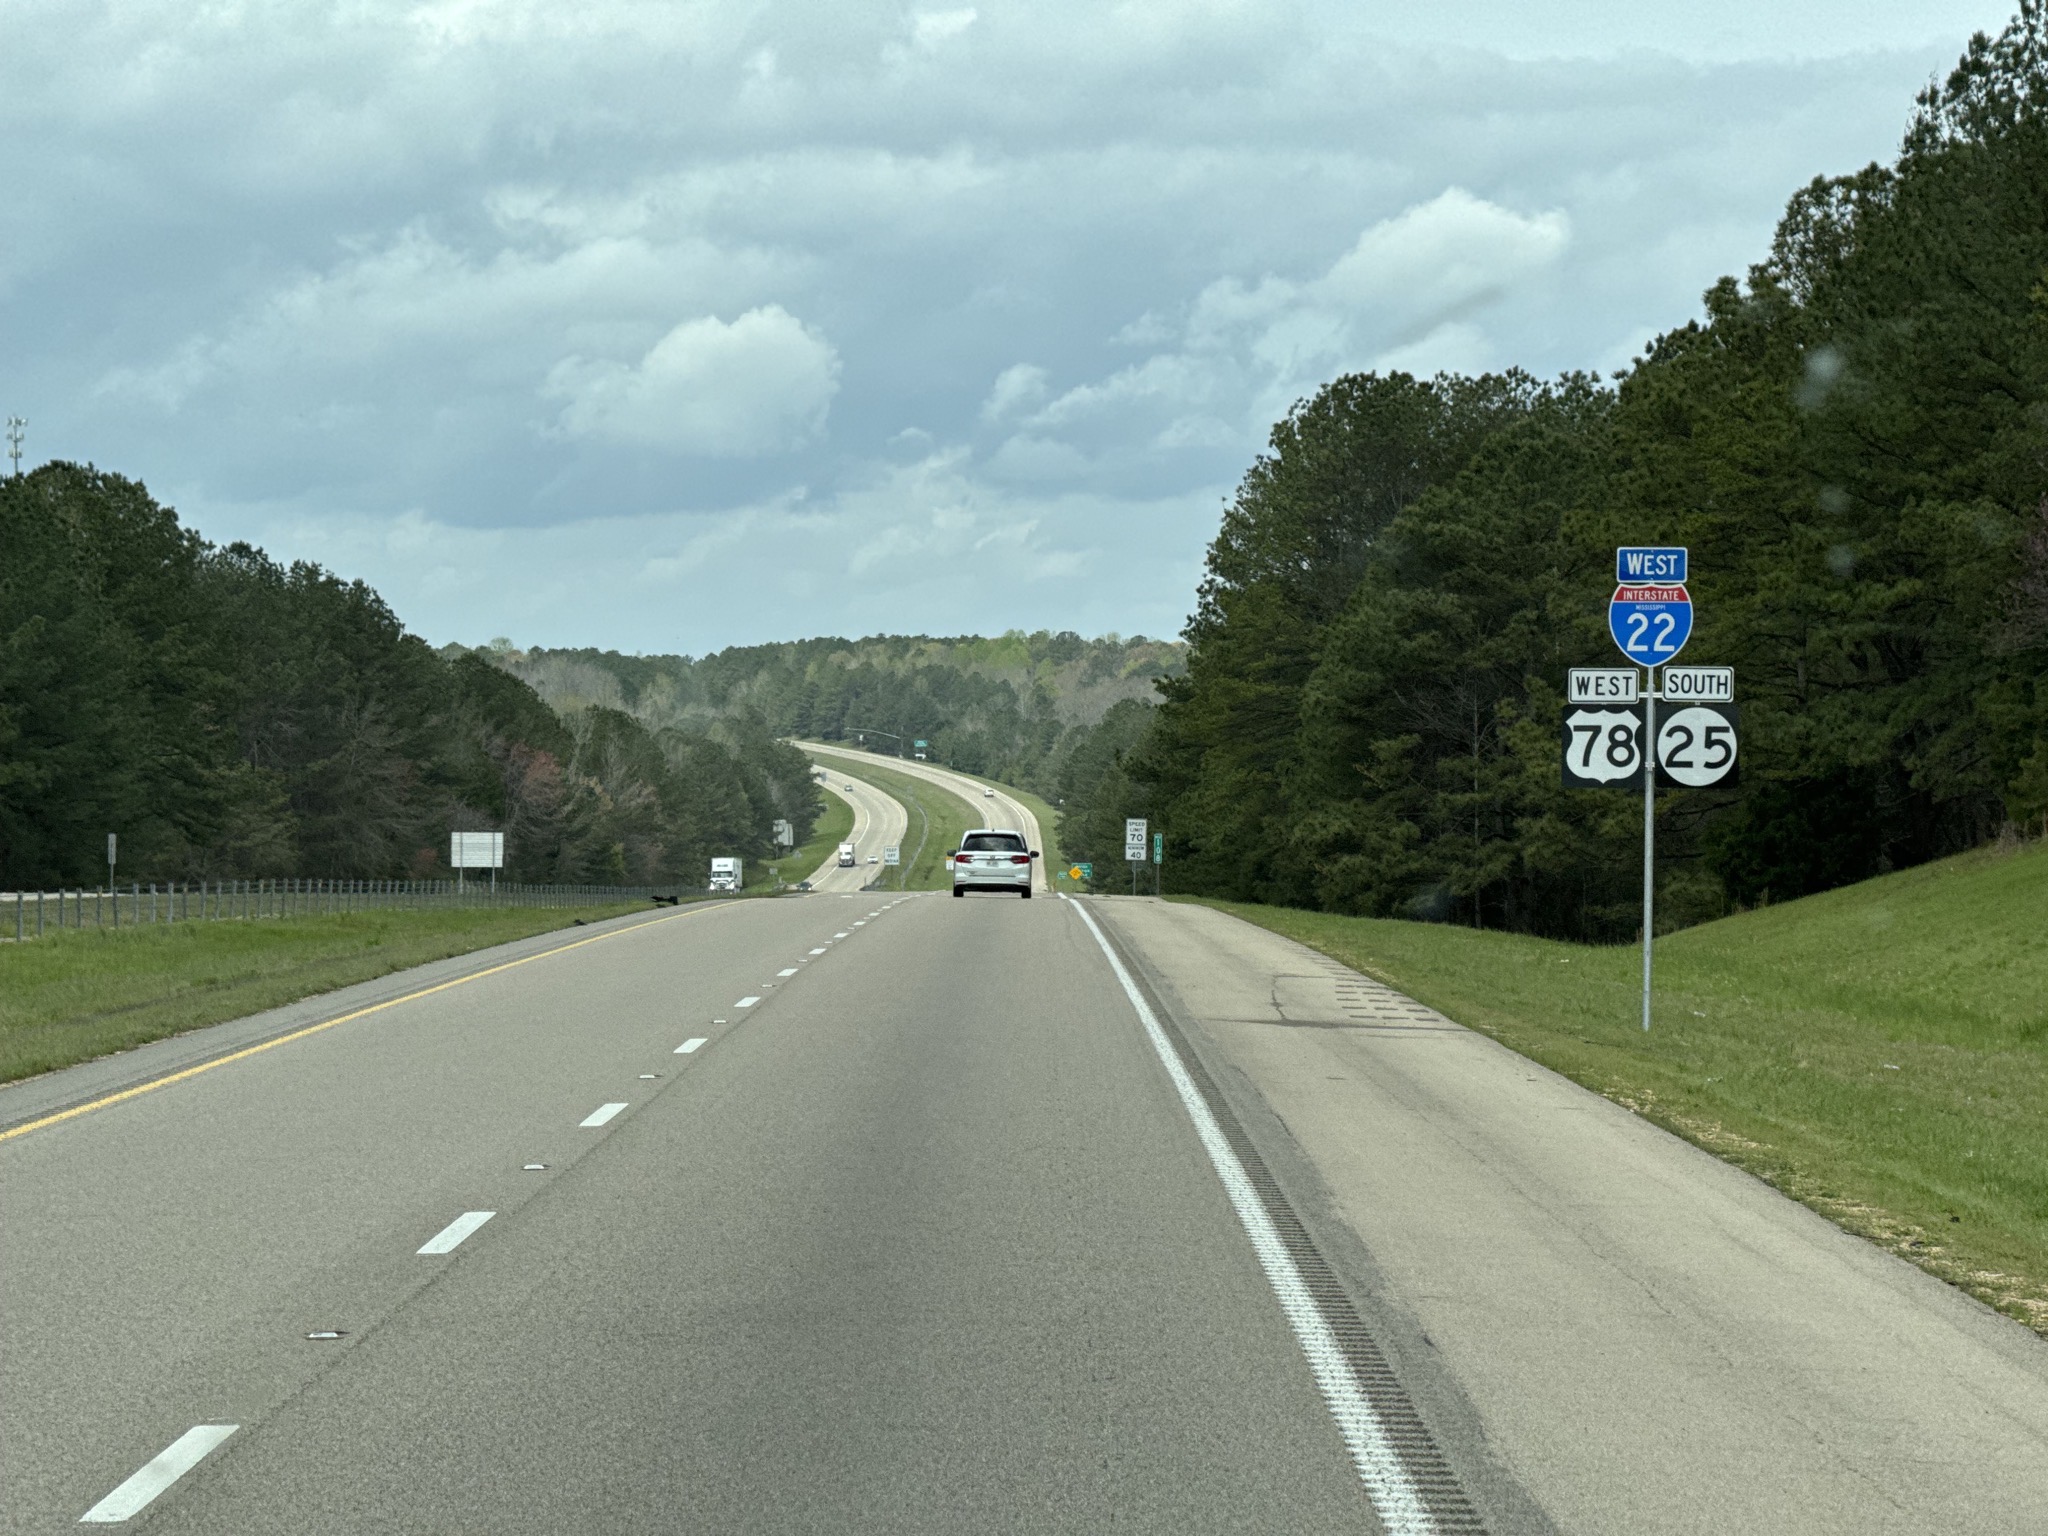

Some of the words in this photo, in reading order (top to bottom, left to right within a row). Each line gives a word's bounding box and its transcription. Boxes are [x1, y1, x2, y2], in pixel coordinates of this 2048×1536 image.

[1627, 553, 1678, 575] WEST
[1623, 590, 1680, 601] INTERSTATE
[1627, 612, 1676, 652] 22
[1576, 676, 1633, 696] WEST
[1668, 673, 1729, 695] SOUTH
[1573, 724, 1635, 767] 78
[1665, 725, 1732, 769] 25
[1130, 834, 1144, 842] 70
[1130, 851, 1142, 859] 40
